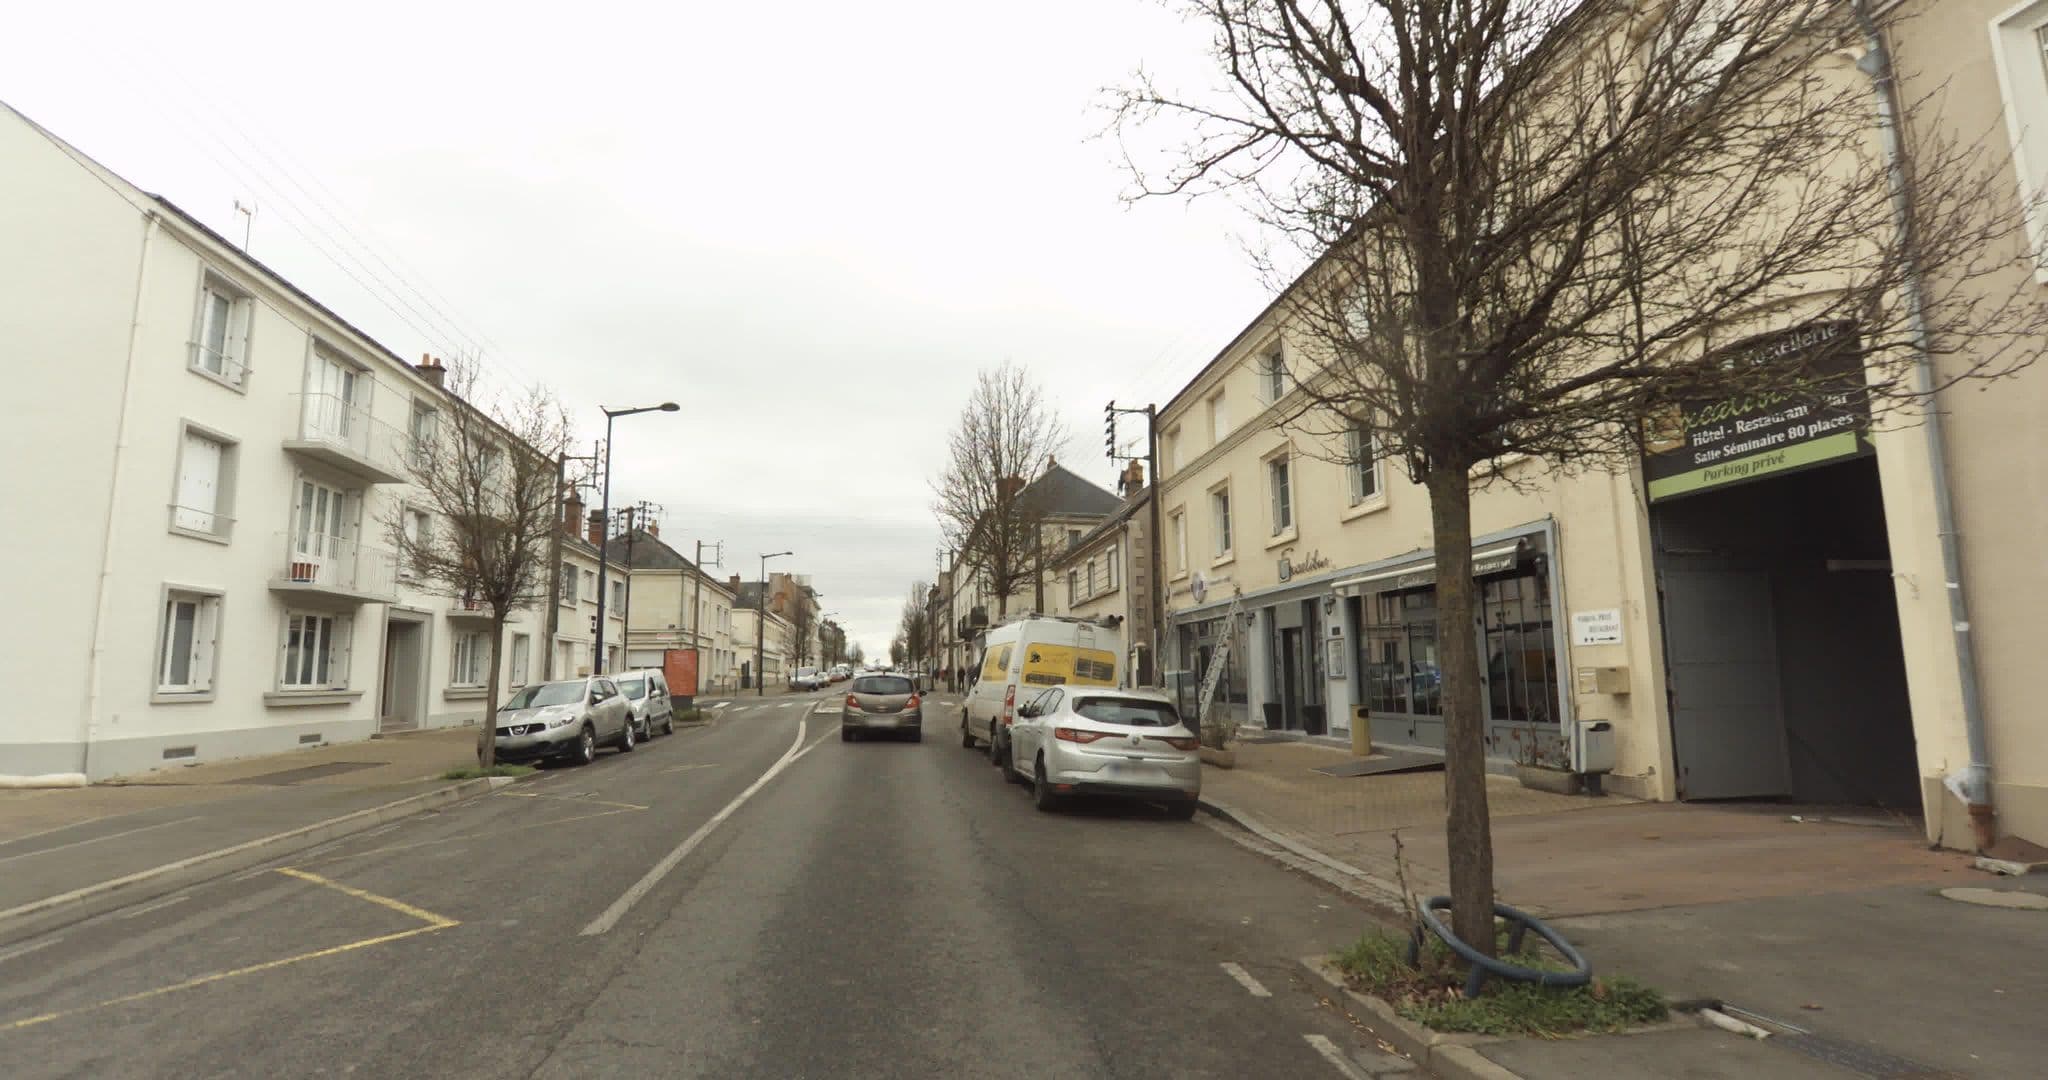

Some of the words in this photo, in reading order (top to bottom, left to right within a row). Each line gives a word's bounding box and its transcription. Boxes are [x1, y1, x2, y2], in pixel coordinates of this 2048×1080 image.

[1694, 448, 1722, 465] Salle
[1722, 430, 1785, 457] Séminaire
[1787, 424, 1806, 440] 80
[1808, 413, 1855, 437] places
[1703, 460, 1750, 482] Parking
[1752, 450, 1786, 473] privé
